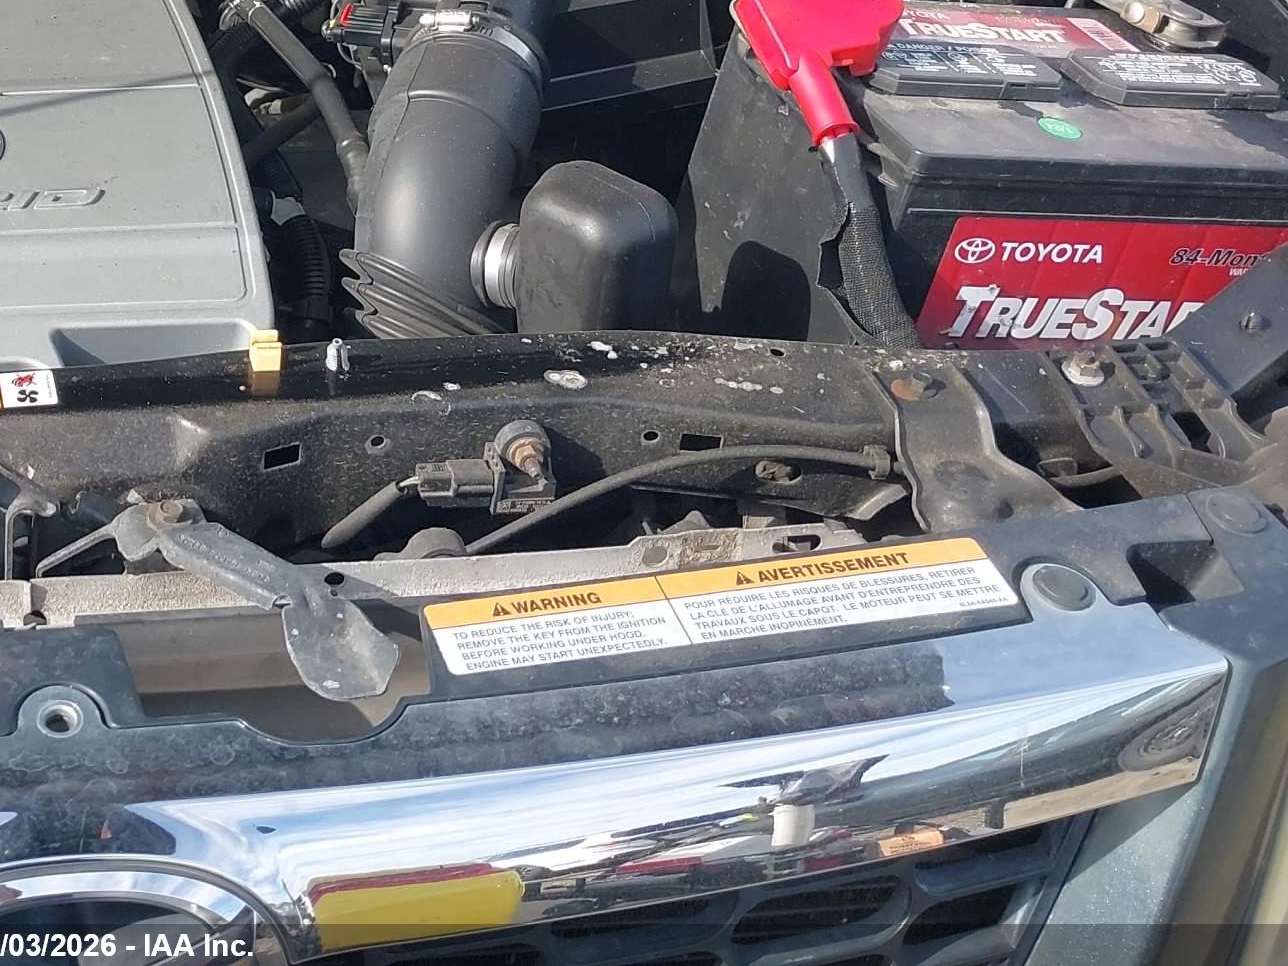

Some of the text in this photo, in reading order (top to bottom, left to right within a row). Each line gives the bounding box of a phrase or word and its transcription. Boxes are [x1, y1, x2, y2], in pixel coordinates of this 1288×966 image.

[904, 9, 950, 20] YOTA
[895, 42, 945, 51] DANGER
[1001, 242, 1268, 267] TOYOTA 84-Mon
[758, 552, 910, 582] AVERTISSEMENT
[683, 599, 716, 609] POUR
[766, 589, 790, 599] LES
[791, 583, 840, 596] RISQUES
[841, 581, 858, 590] DE
[928, 567, 976, 580] RETIRER
[689, 611, 706, 620] LA
[730, 606, 748, 615] DE
[819, 592, 855, 604] AVANT
[957, 577, 981, 587] DES
[511, 592, 602, 614] WARNING
[697, 585, 997, 630] TRAVAUX SOUS LE CAPOT. LE MOTEUR PEUT SE METTRE
[452, 631, 469, 640] TO
[469, 625, 517, 638] REDUCE
[520, 621, 543, 632] THE
[544, 618, 571, 629] RISK
[572, 616, 589, 626] OF
[456, 617, 667, 651] REMOVE THE KEY FROM THE IGNITION
[700, 631, 717, 640] EN
[718, 624, 768, 638] MARCHE
[461, 647, 508, 661] BEFORE
[510, 640, 566, 655] WORKING
[567, 635, 607, 647] UNDER
[466, 638, 666, 671] ENGINE MAY START UNEXPECTEDLY.
